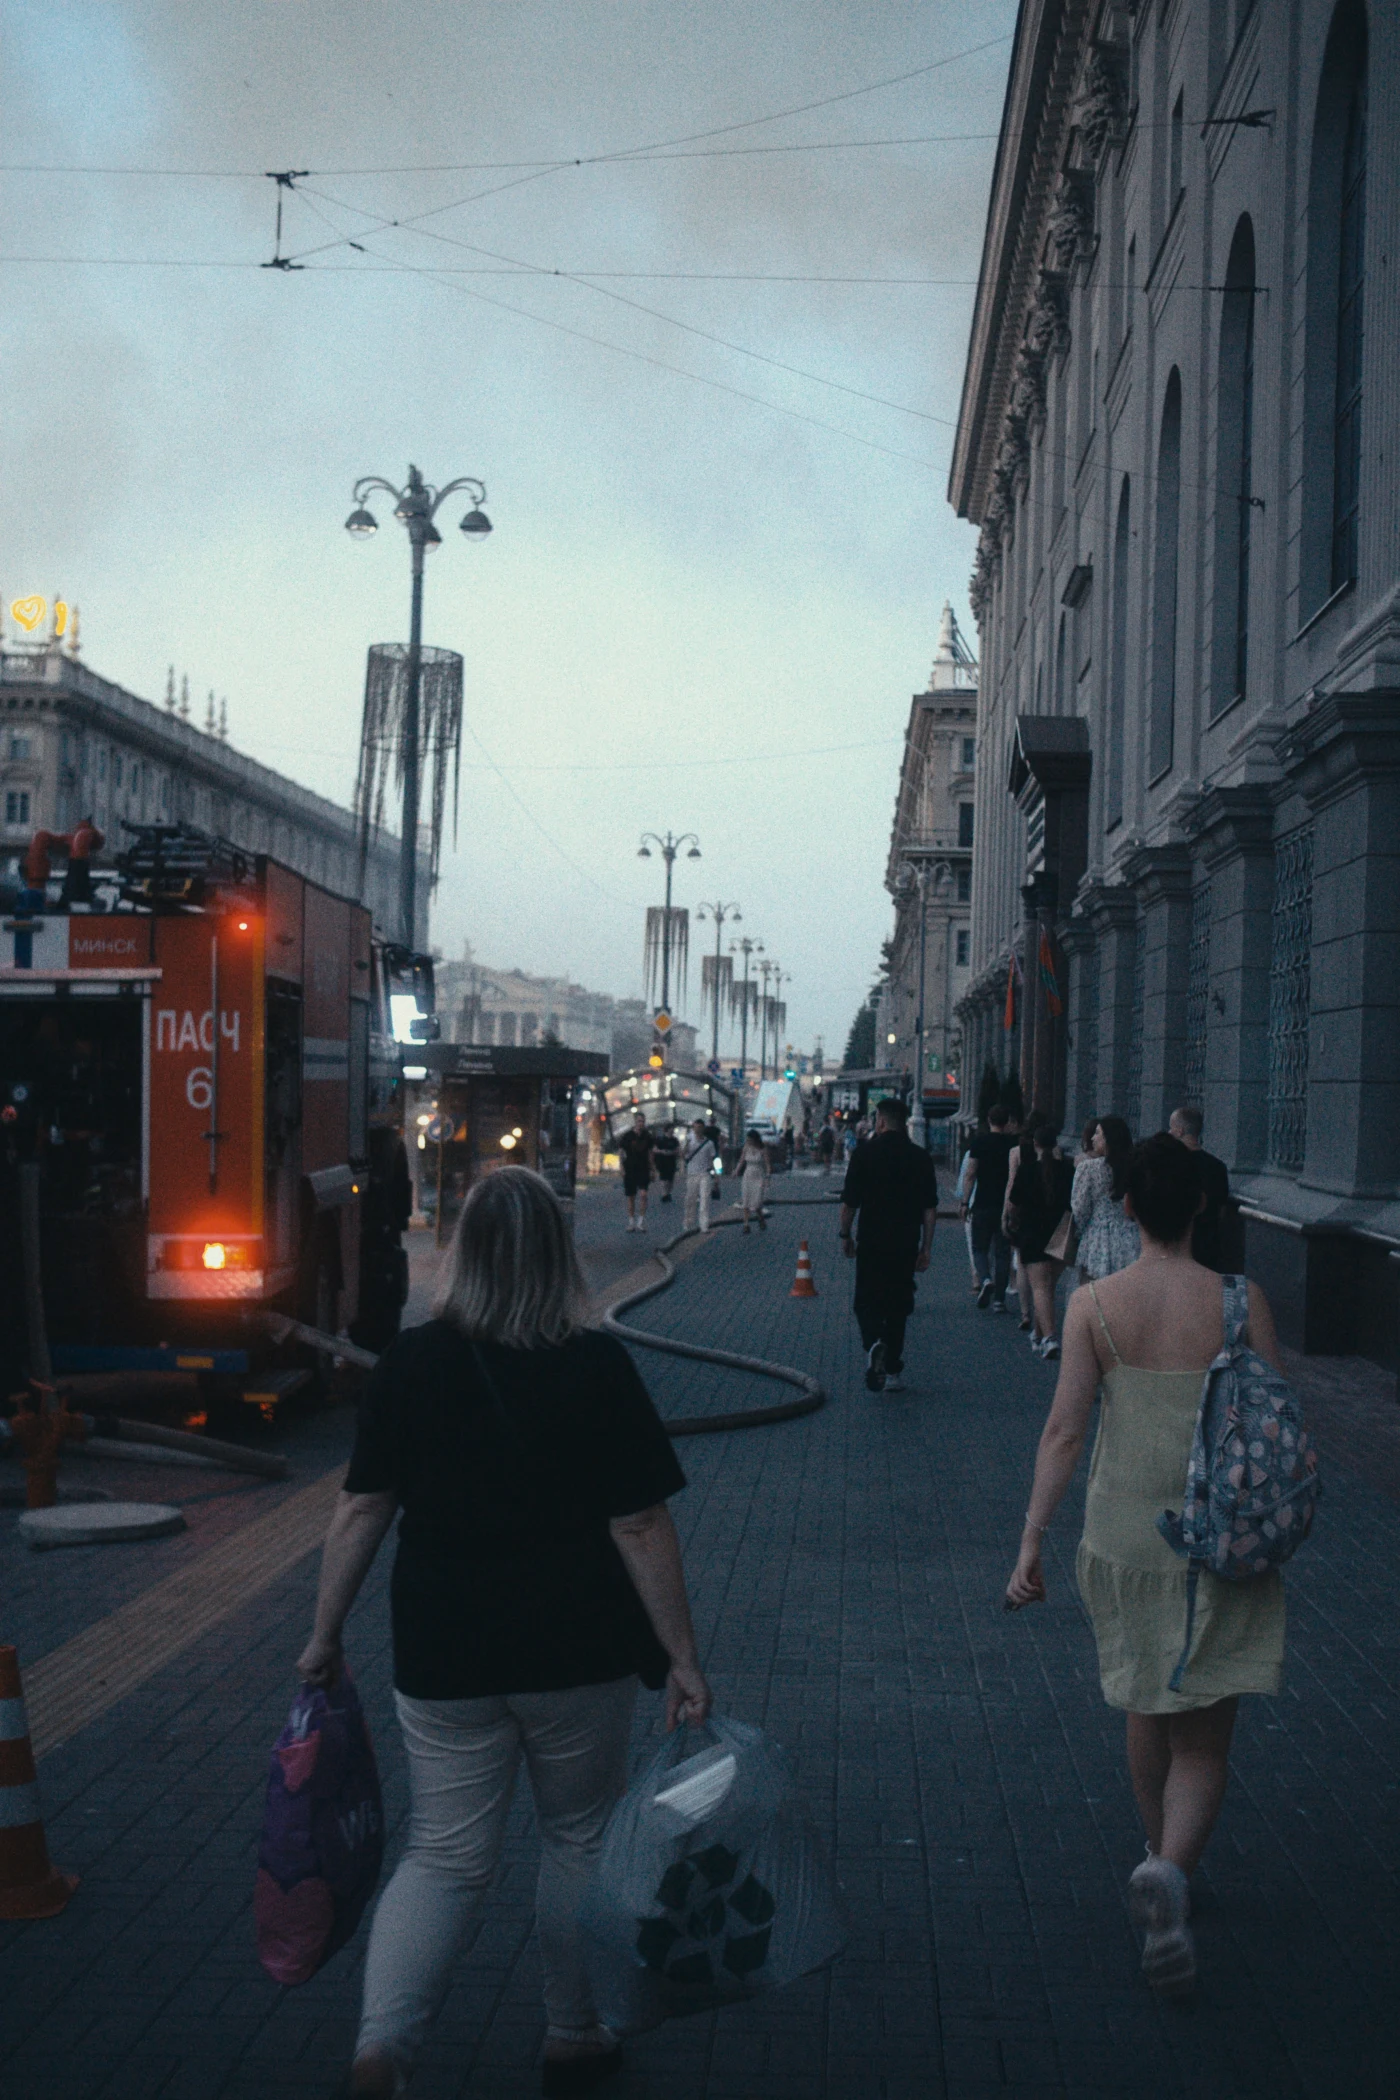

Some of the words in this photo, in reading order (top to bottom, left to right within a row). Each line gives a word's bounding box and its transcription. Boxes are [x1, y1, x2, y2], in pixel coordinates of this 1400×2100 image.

[73, 938, 137, 954] МИНСК
[156, 1009, 240, 1052] ПАСЧ
[186, 1066, 214, 1110] 6
